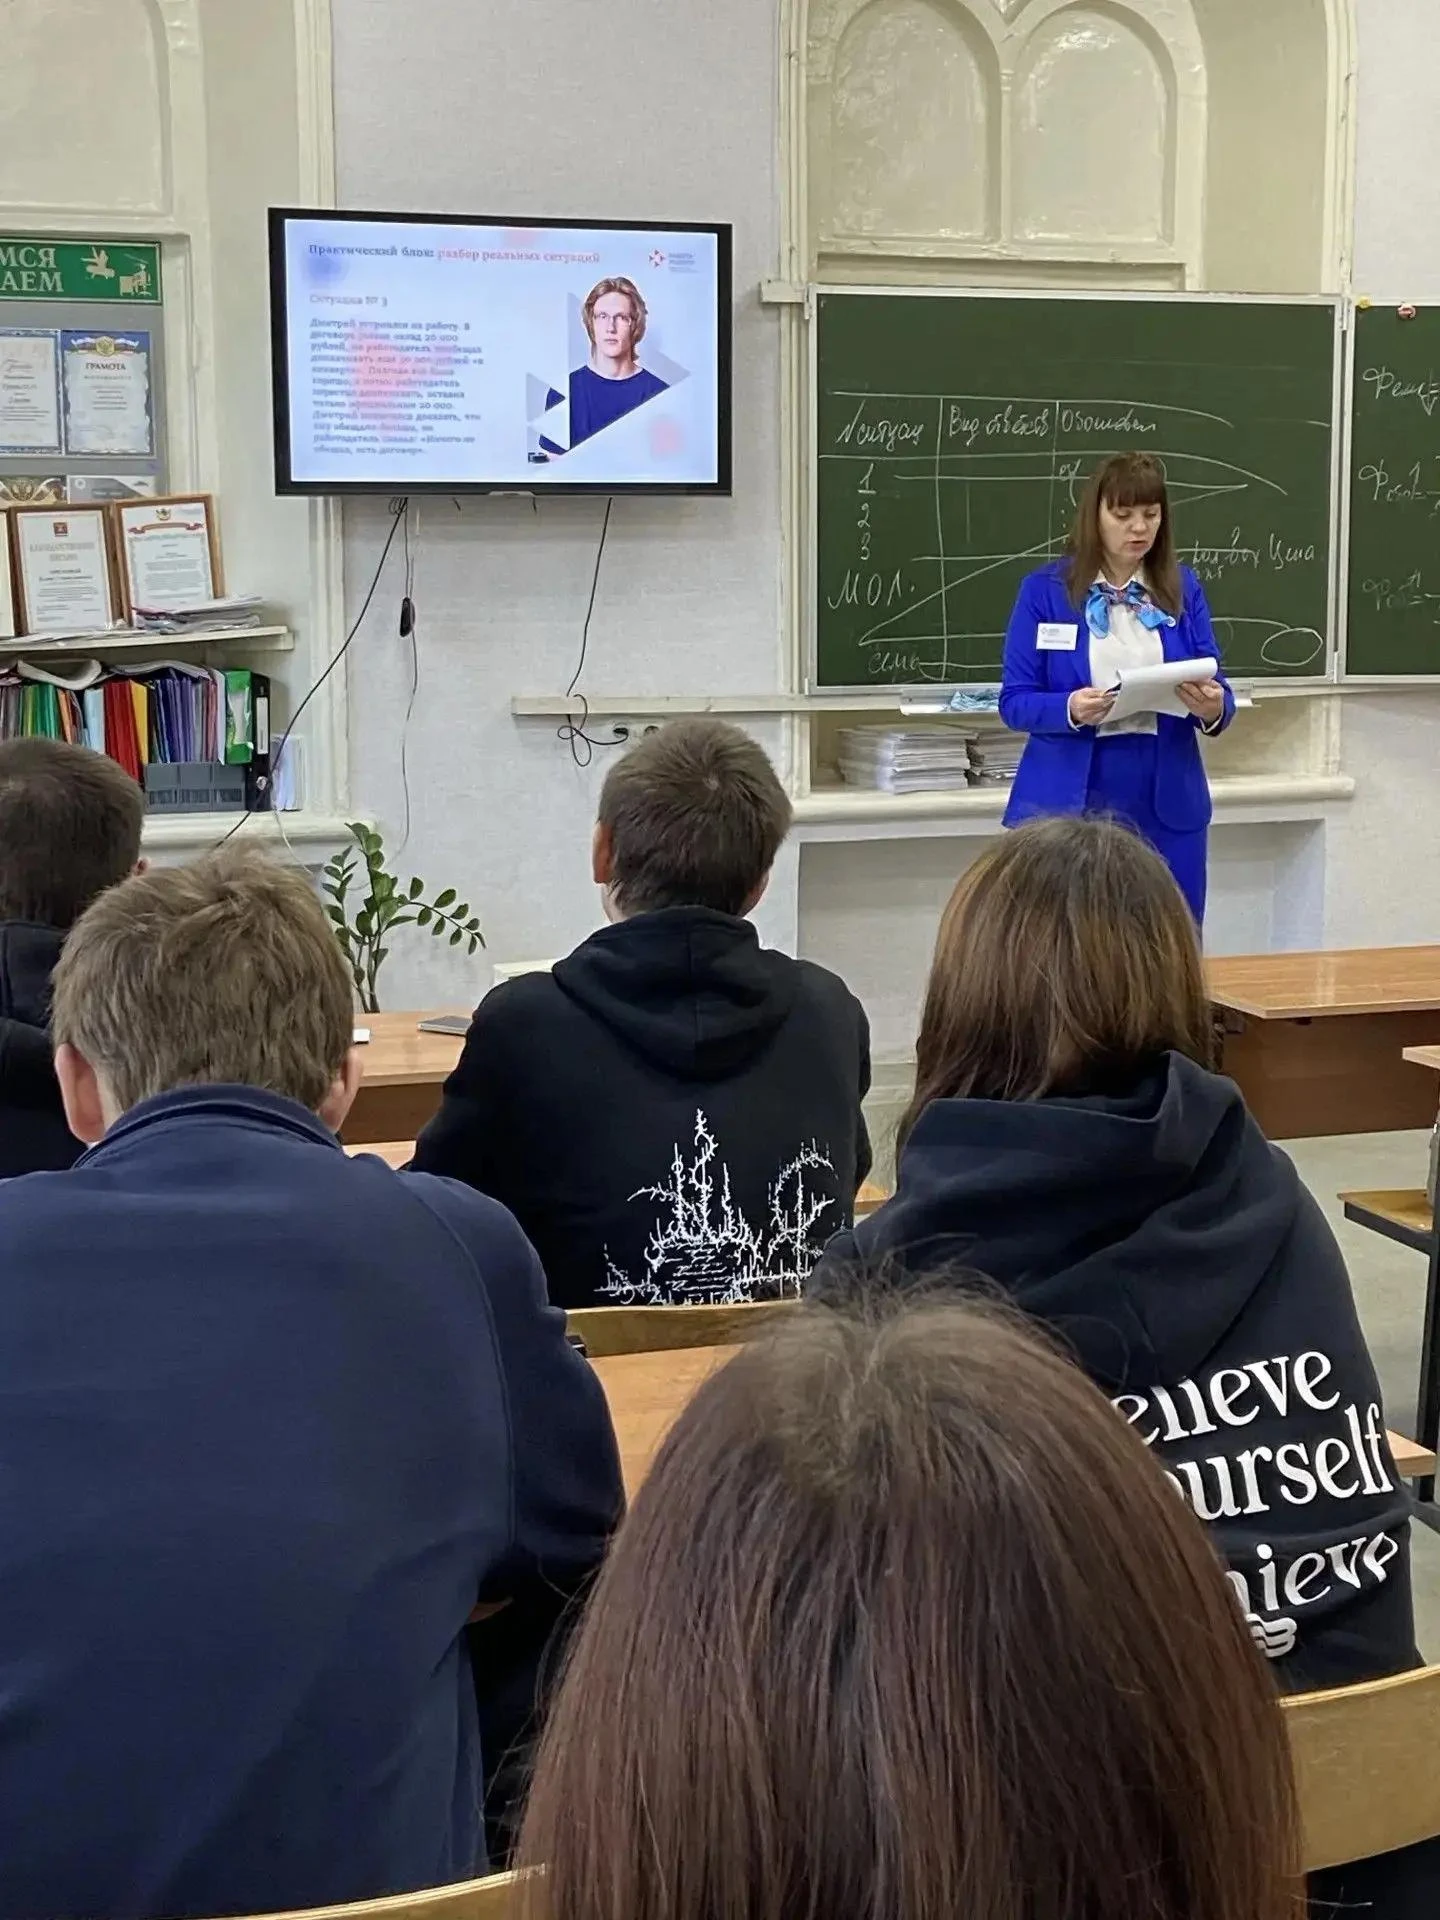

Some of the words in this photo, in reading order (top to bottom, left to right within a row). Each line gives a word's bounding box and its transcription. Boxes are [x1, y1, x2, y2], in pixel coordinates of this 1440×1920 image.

[309, 244, 398, 257] Практический
[438, 249, 479, 262] разбор
[482, 250, 540, 262] реальных
[543, 252, 600, 265] ситуаций
[309, 294, 363, 306] Ситуация
[310, 318, 355, 329] Дмитрий
[85, 362, 126, 371] ГРАМОТА
